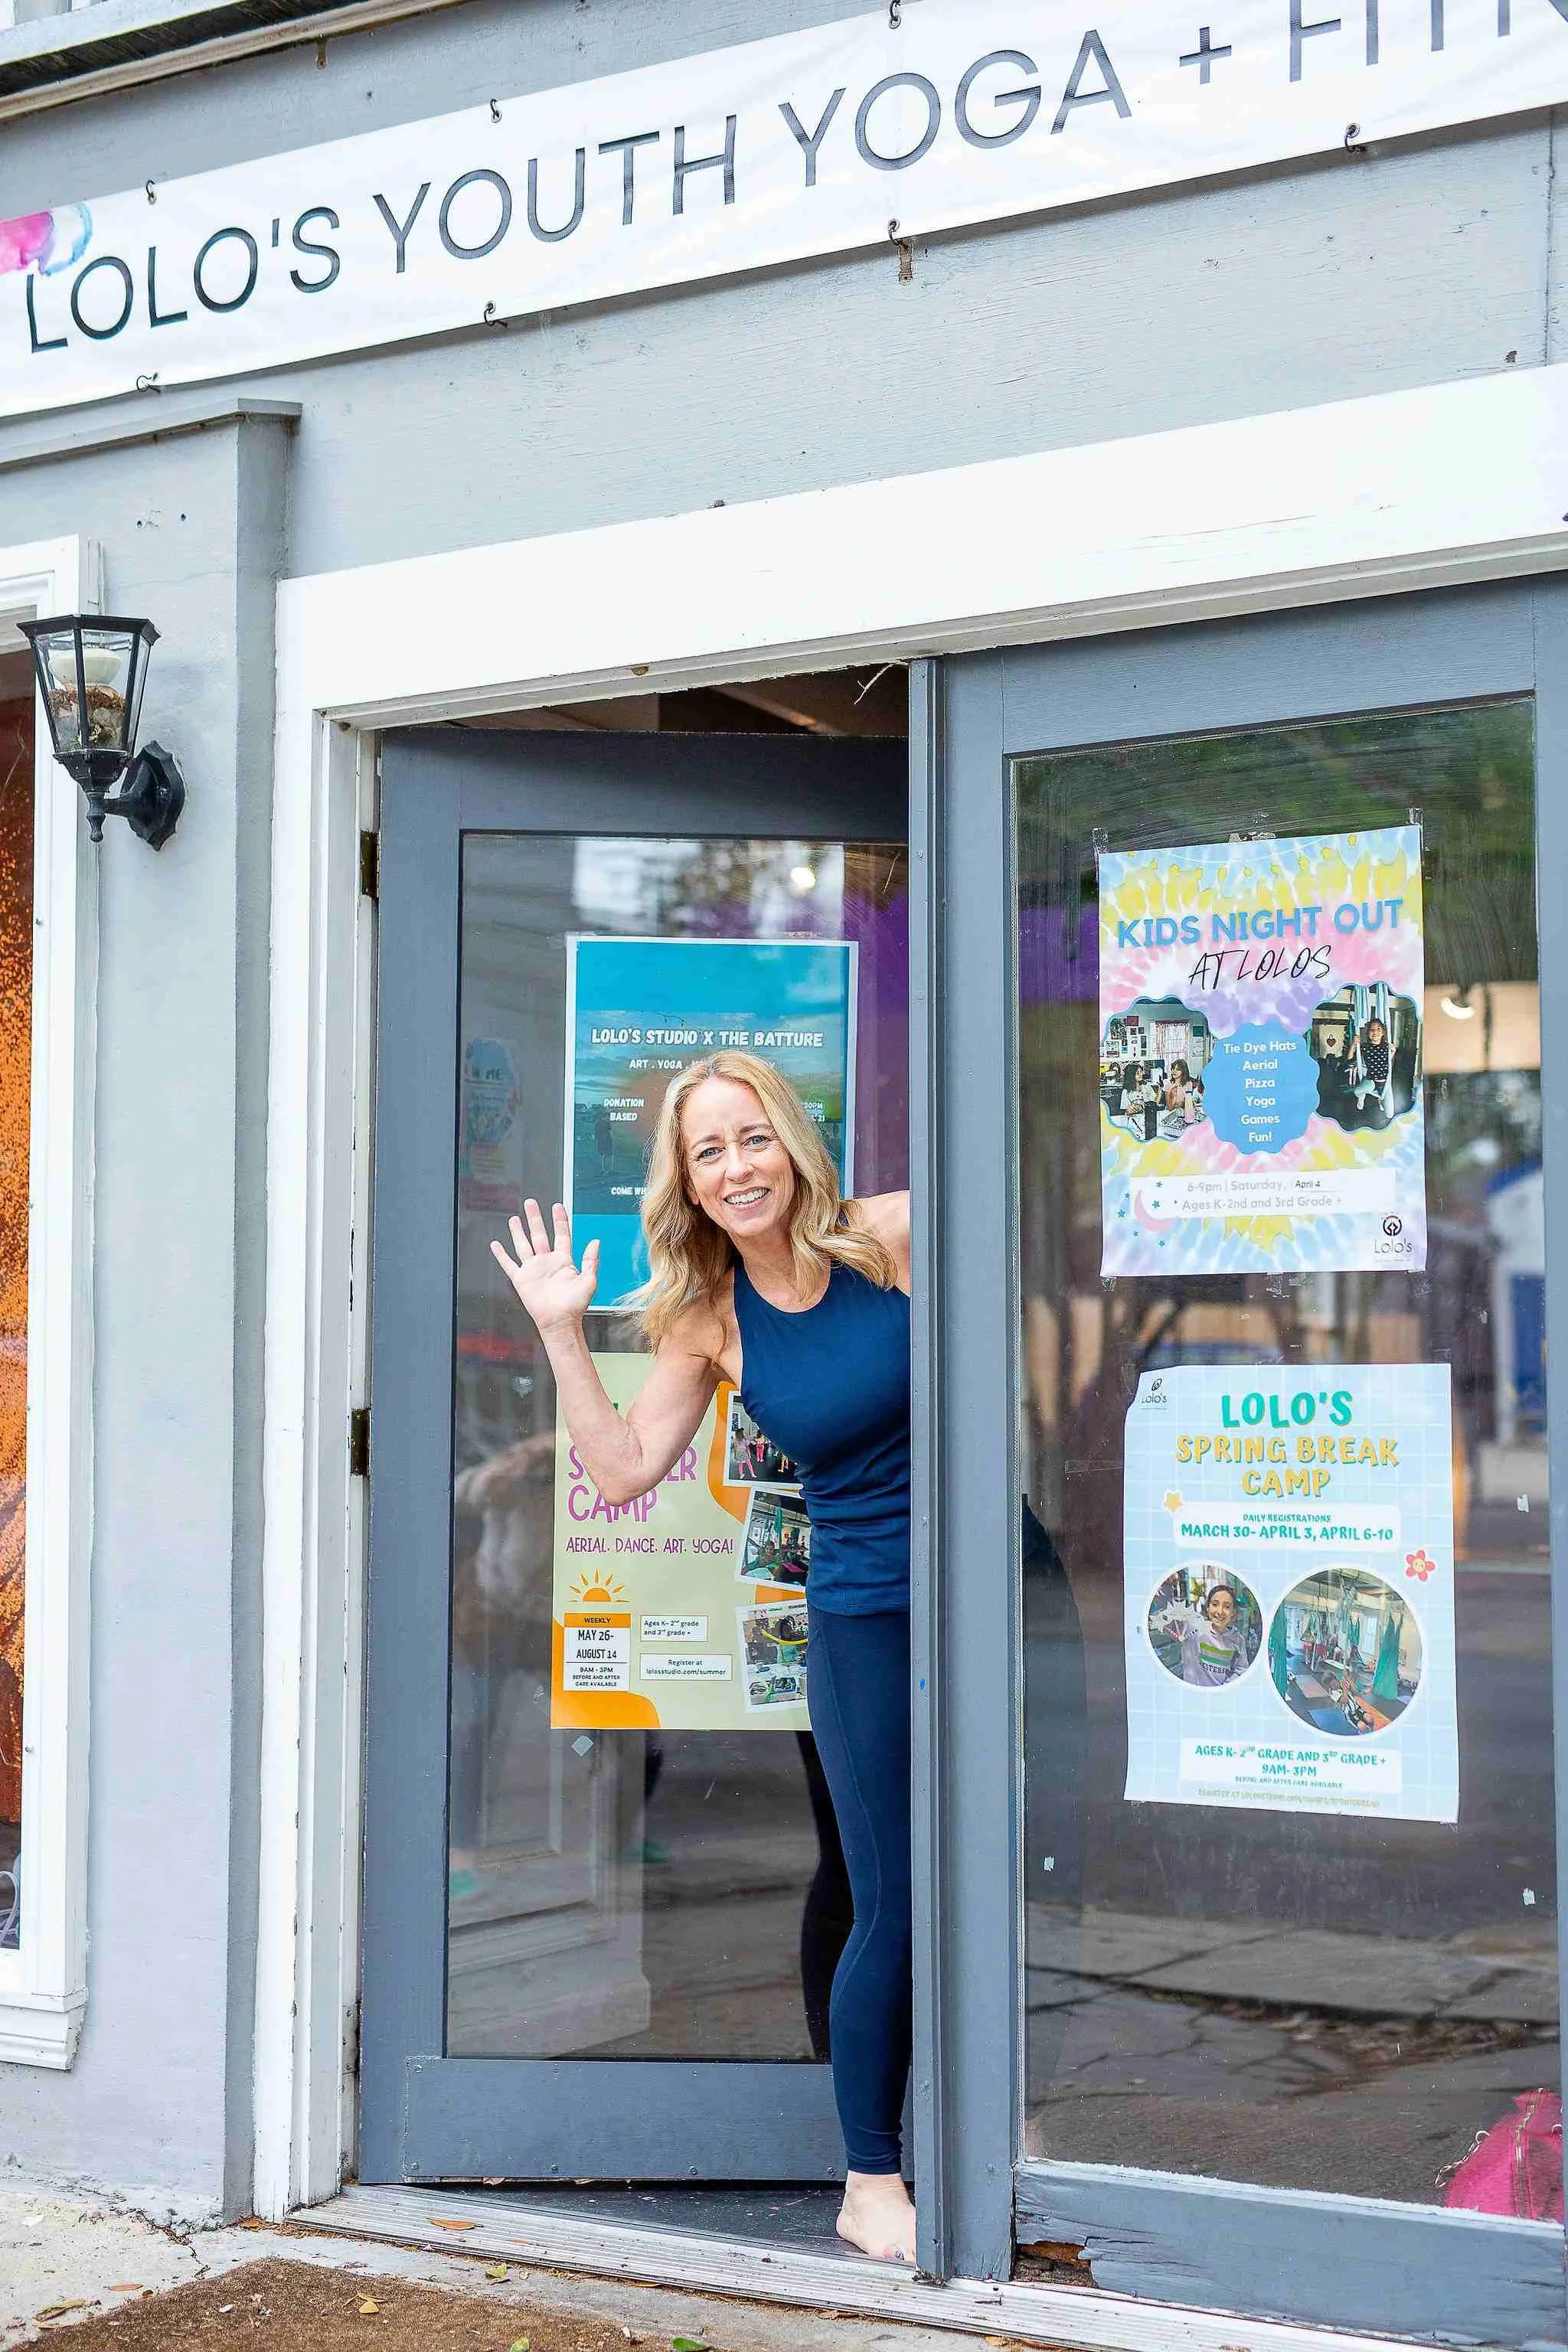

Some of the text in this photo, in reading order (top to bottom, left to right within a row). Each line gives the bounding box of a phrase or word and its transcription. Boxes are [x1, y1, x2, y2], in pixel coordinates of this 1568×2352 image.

[25, 206, 341, 354] LOLO'S
[372, 114, 737, 274] YOUTH
[778, 28, 1132, 188] YOGA
[1179, 27, 1232, 84] +
[1117, 899, 1403, 949] KIDS NIGHT OUT
[1188, 945, 1331, 990] AT LOLOS
[591, 1027, 824, 1047] LOLO'S STUDIO X THE BATTURE
[1223, 1041, 1297, 1054] Tie Dye Hats
[629, 1059, 649, 1069] ART
[657, 1060, 683, 1070] YOGA
[1242, 1059, 1278, 1070] Aerial
[1245, 1078, 1276, 1089] Pizza
[603, 1098, 644, 1107] DONATION
[1245, 1096, 1276, 1108] Yoga
[609, 1112, 638, 1122] BASED
[1240, 1115, 1281, 1125] Games
[1249, 1132, 1272, 1142] Fun!
[1187, 1182, 1223, 1194] 6-9pm
[1230, 1179, 1286, 1192] Saturday,
[1295, 1180, 1313, 1189] April
[611, 1187, 633, 1195] COME
[1181, 1200, 1210, 1212] Ages
[1251, 1197, 1271, 1208] and
[1275, 1197, 1293, 1207] 3rd
[1298, 1196, 1333, 1206] Grade
[1374, 1238, 1412, 1253] Lolo's
[1221, 1390, 1354, 1428] LOLO'S
[1175, 1434, 1400, 1467] SPRING BREAK
[1241, 1468, 1331, 1498] CAMP
[568, 1485, 658, 1523] CAMP
[1243, 1514, 1331, 1523] DAILY REGISTRATIONS
[1181, 1523, 1230, 1538] MARCH
[1259, 1525, 1301, 1539] APRIL
[1304, 1527, 1316, 1542] 3,
[1320, 1526, 1361, 1540] APRIL
[1364, 1527, 1393, 1540] 6-10
[692, 1538, 733, 1554] YOGA!
[681, 1620, 699, 1628] grade
[577, 1629, 597, 1641] MAY
[576, 1648, 617, 1659] AUGUST 14
[1195, 1745, 1224, 1756] AGES
[1258, 1748, 1293, 1760] GRADE
[1297, 1750, 1321, 1762] AND
[1341, 1753, 1378, 1766] GRADE
[1293, 1766, 1317, 1776] 3PM
